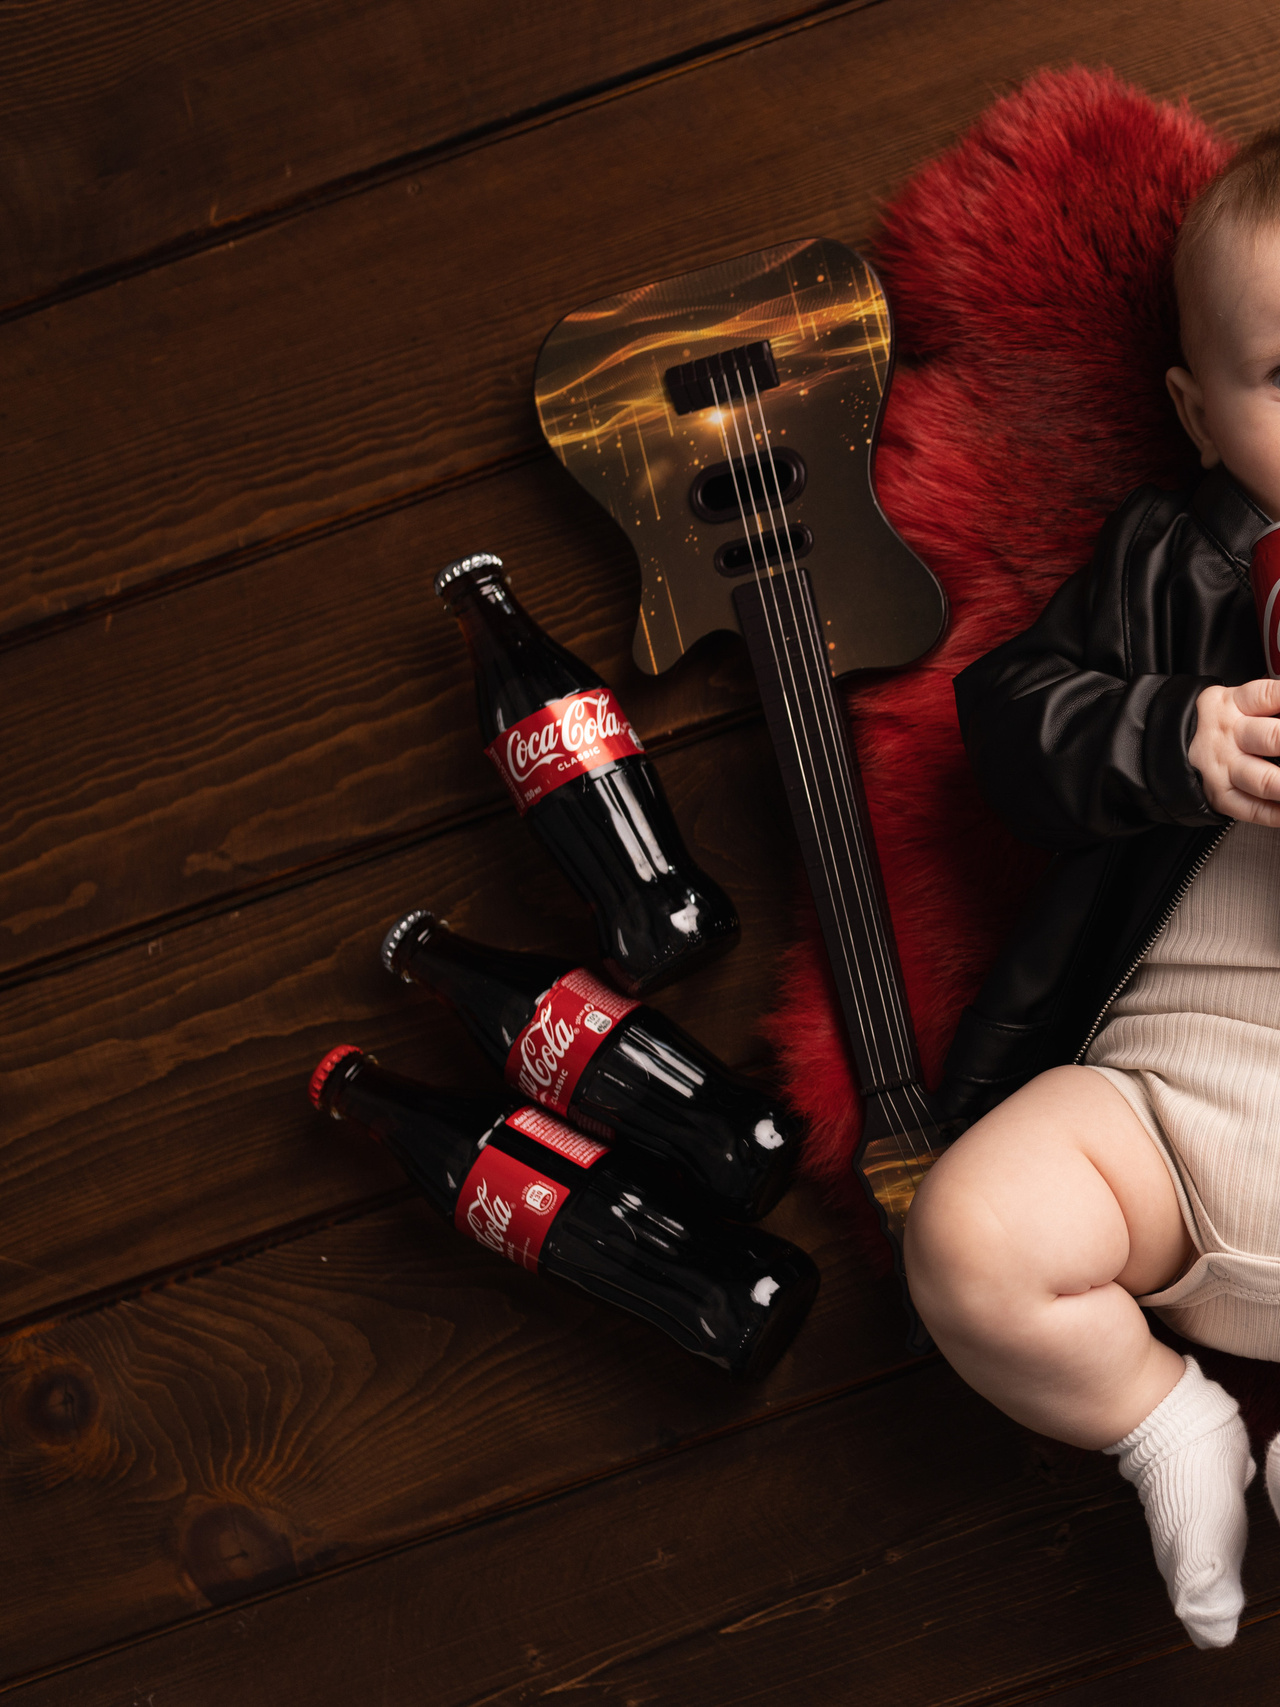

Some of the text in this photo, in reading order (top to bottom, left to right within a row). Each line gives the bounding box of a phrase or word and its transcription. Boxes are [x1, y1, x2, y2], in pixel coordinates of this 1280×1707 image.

[507, 694, 621, 783] Coca-Cola
[557, 746, 601, 772] CLASSIC
[551, 1068, 569, 1106] CLASSIC
